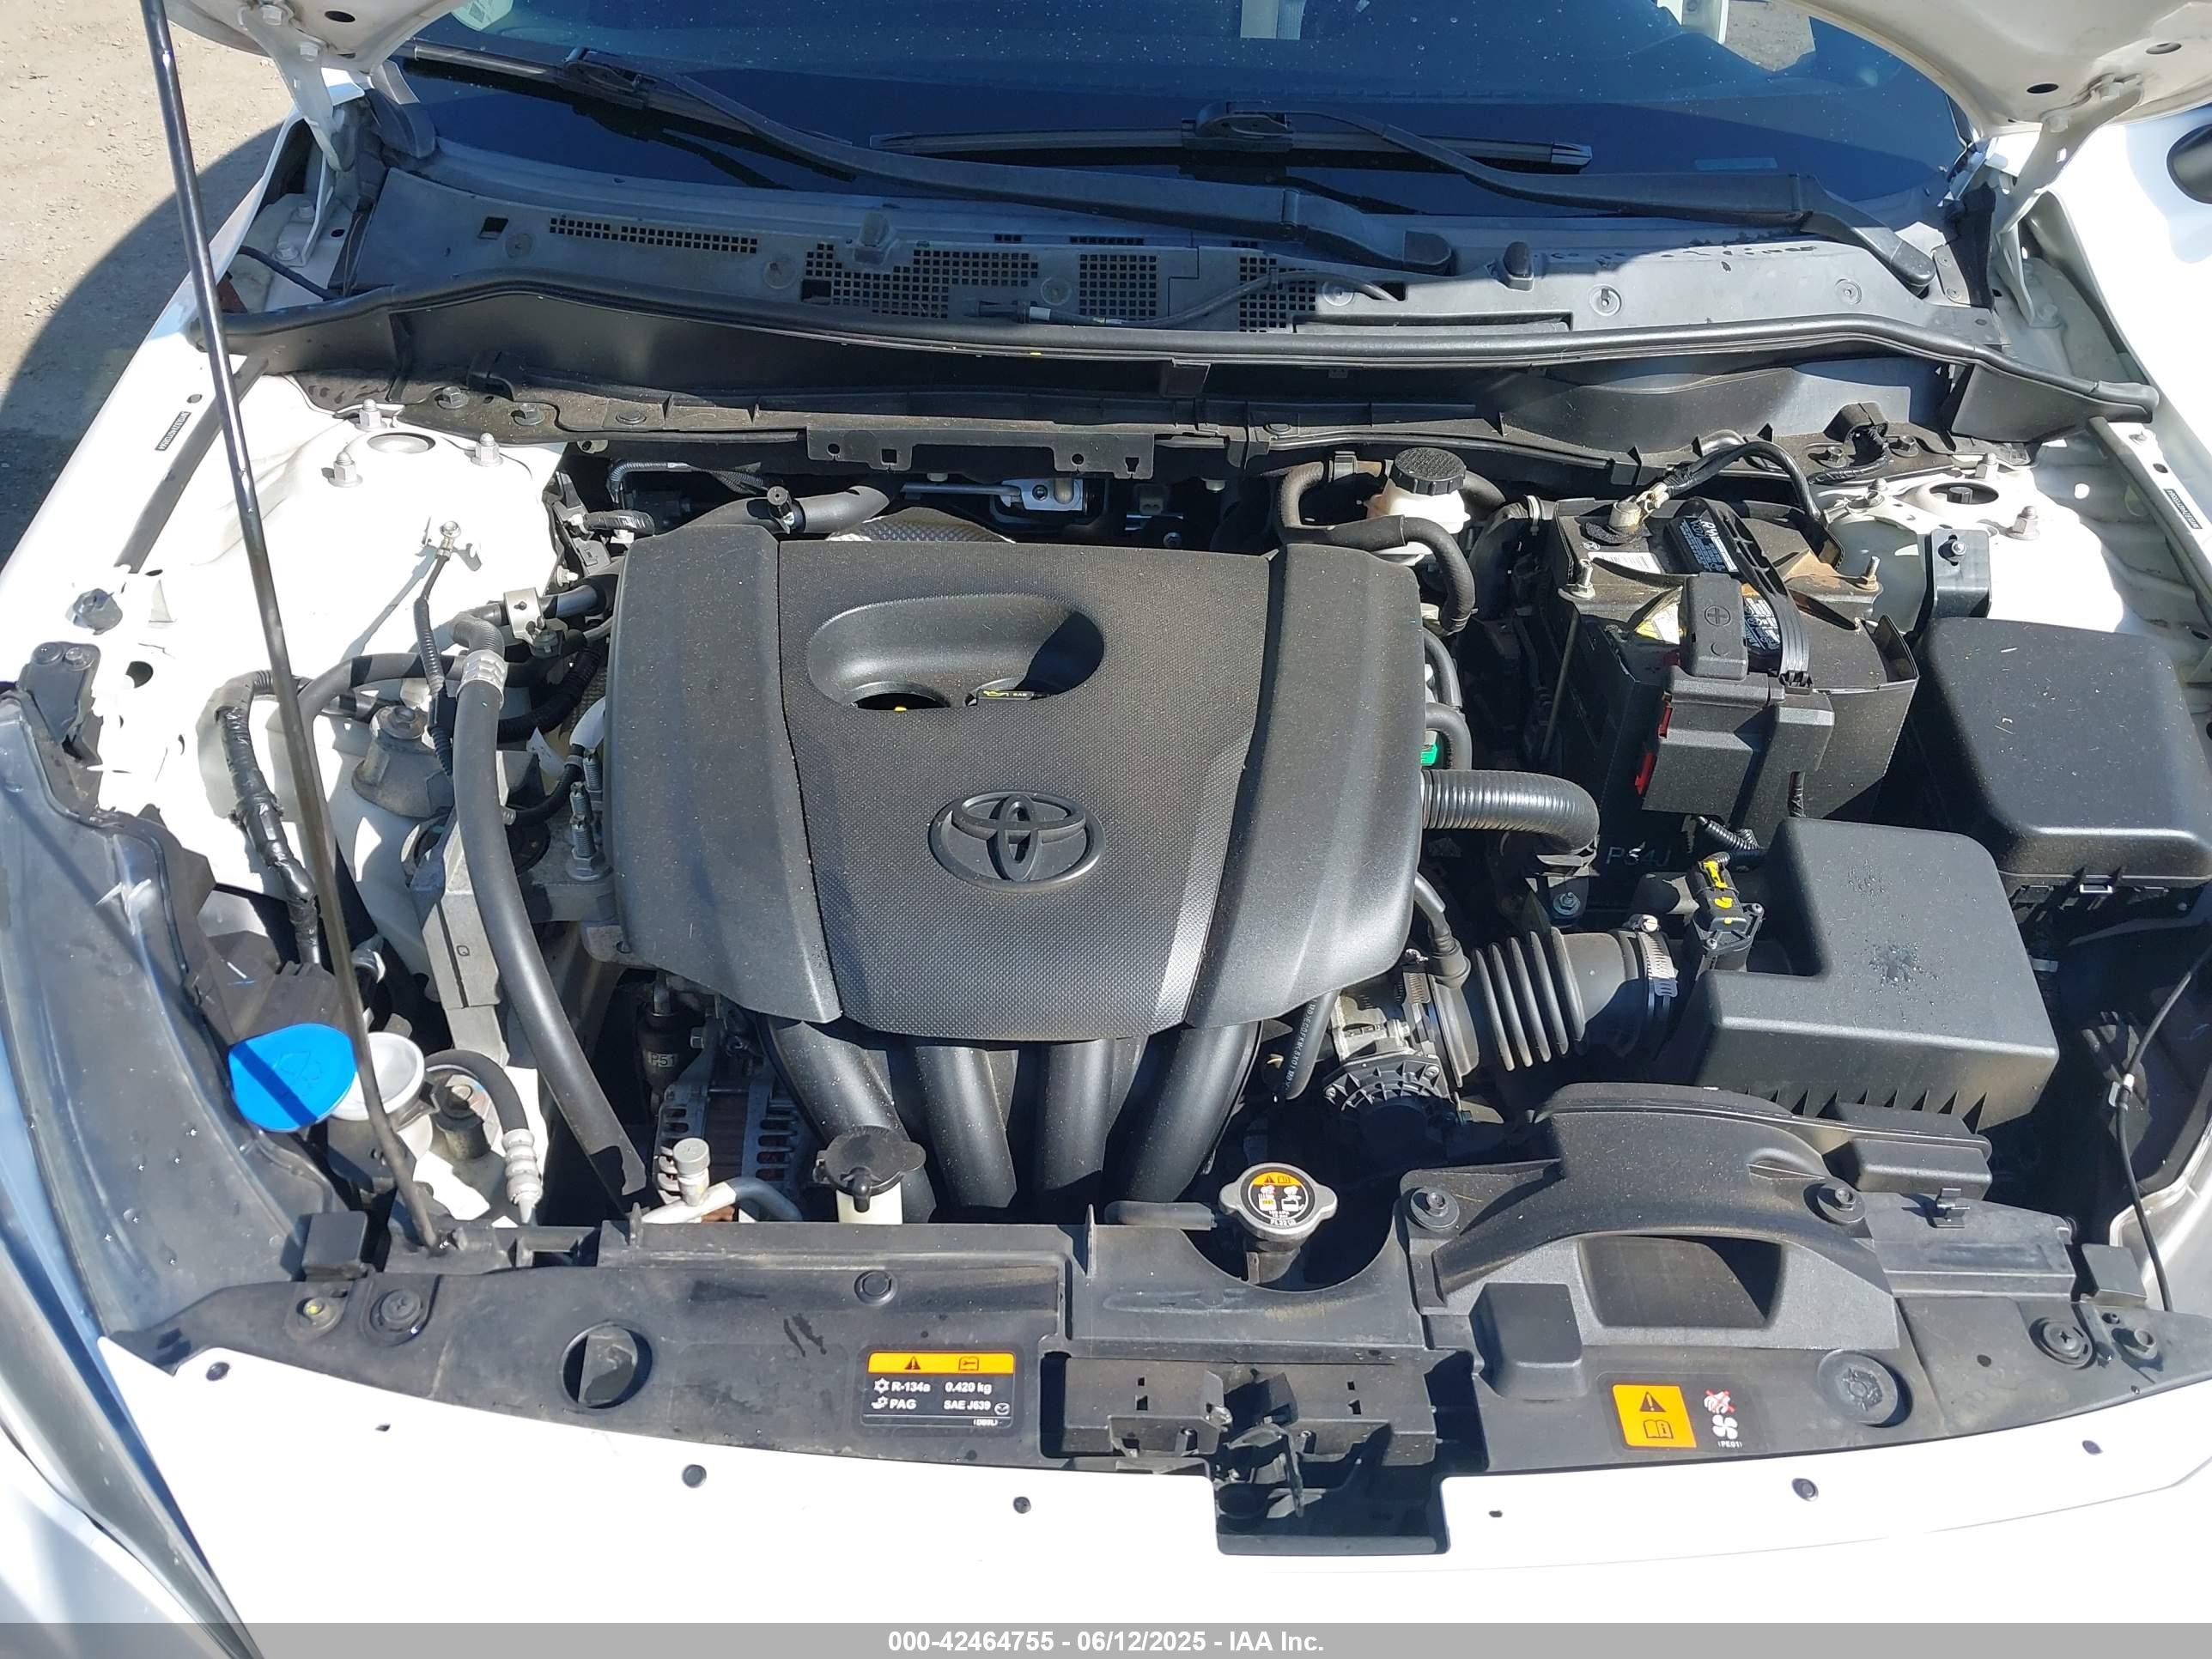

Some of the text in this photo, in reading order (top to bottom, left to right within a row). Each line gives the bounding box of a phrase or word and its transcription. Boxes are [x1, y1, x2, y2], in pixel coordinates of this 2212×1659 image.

[891, 1381, 993, 1395] R-134a 0.420 kg
[889, 1399, 917, 1410] PAG
[944, 1400, 967, 1411] SAE
